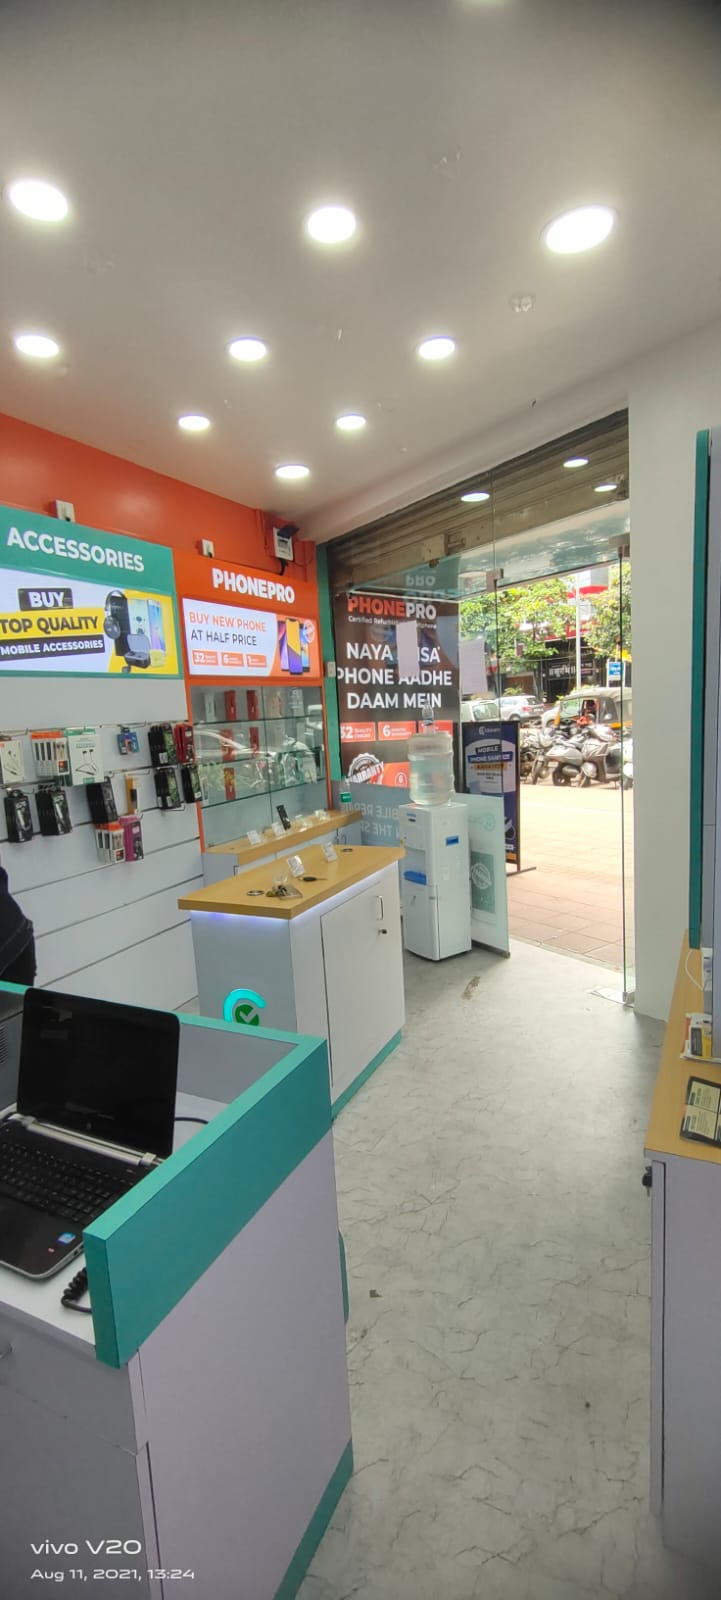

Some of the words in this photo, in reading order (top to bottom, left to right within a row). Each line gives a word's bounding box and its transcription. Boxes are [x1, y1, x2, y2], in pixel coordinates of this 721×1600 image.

[7, 527, 144, 572] ACCESSORIES
[211, 568, 295, 604] PHONEPRO
[28, 591, 65, 608] BUY
[347, 596, 437, 620] PHONEPRO
[0, 619, 32, 634] TOP
[37, 616, 98, 634] QUALITY
[189, 612, 209, 624] BUY
[212, 616, 237, 628] NEW
[237, 618, 267, 632] PHONE
[348, 615, 373, 624] Certified
[191, 630, 203, 641] AT
[206, 631, 229, 643] HALF
[232, 634, 257, 646] PRICE
[0, 644, 40, 656] MOBILE
[43, 640, 103, 652] ACCESSORIES
[346, 642, 393, 661] NAYA
[193, 652, 205, 663] 32
[223, 654, 229, 664] 6
[346, 692, 398, 709] DAAM
[403, 693, 442, 709] MEIN
[382, 725, 391, 737] 6
